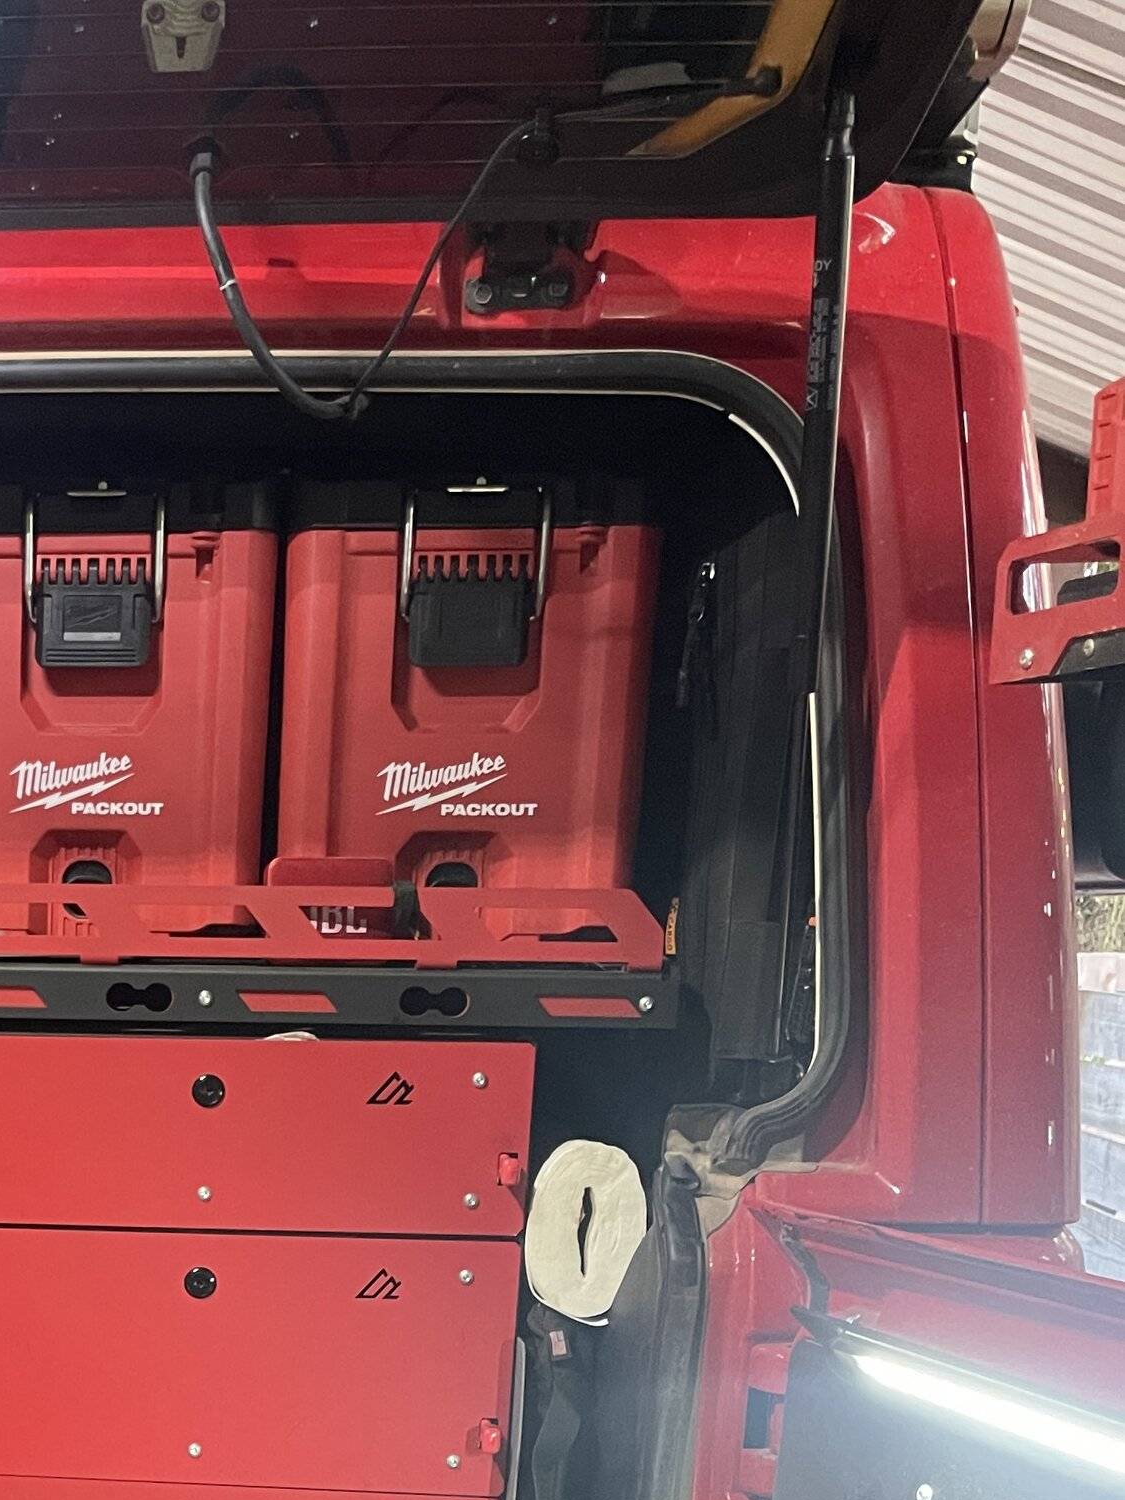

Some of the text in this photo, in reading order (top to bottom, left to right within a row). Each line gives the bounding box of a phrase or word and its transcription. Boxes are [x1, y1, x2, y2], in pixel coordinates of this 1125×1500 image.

[9, 751, 133, 800] Milwaukee
[376, 751, 507, 802] Milwaukee
[71, 801, 165, 816] PACKOUT
[440, 803, 538, 817] PACKOUT
